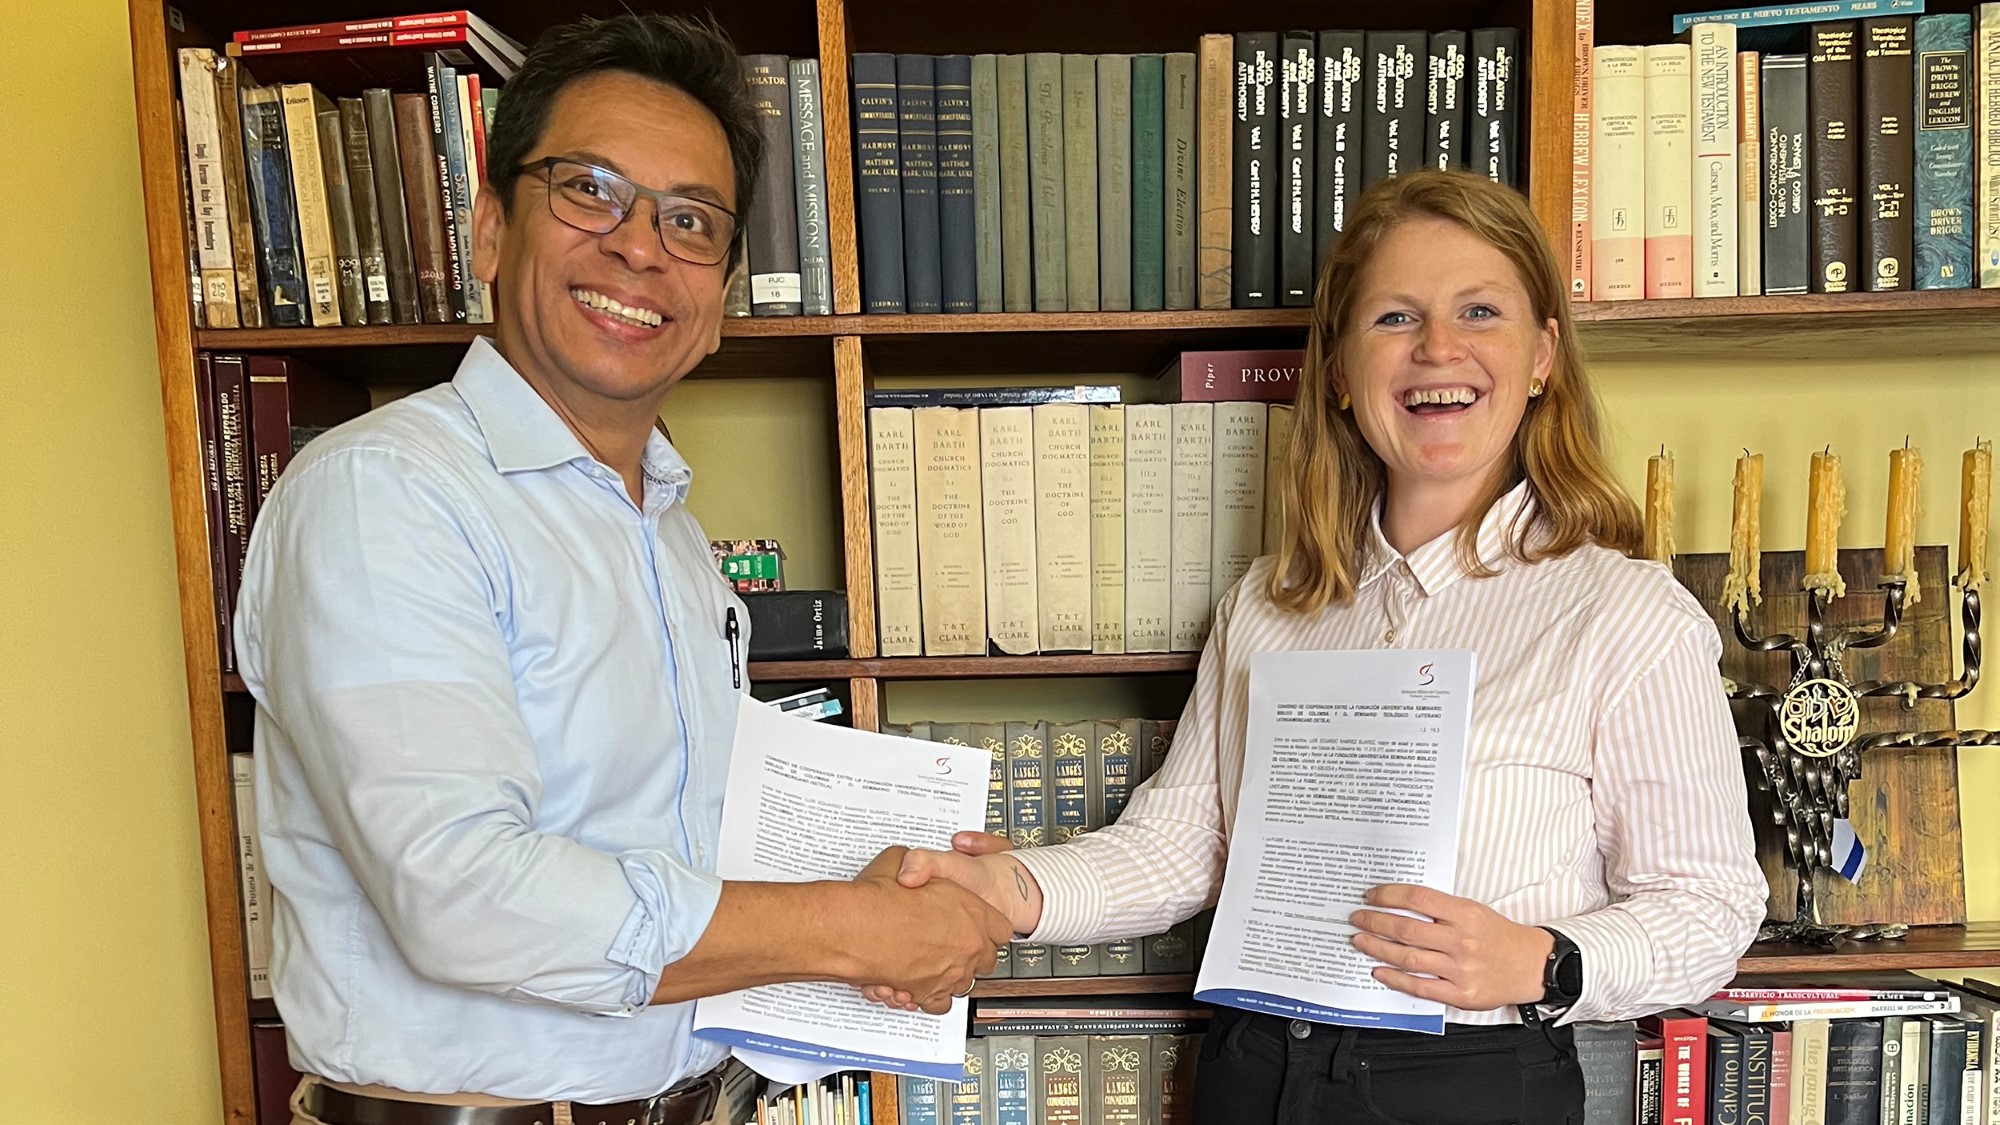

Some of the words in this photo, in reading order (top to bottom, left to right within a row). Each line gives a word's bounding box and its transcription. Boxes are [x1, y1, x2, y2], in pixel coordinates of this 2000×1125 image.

[1741, 11, 1752, 19] EL
[1753, 9, 1783, 18] NUEVO
[1784, 4, 1840, 16] TESTAMENTO
[1579, 32, 1586, 41] to
[1701, 32, 1714, 45] TO
[1872, 27, 1907, 35] Theological
[1581, 43, 1589, 76] BROWN
[1701, 47, 1714, 66] THE
[1716, 45, 1728, 59] AN
[1866, 49, 1880, 57] Old
[427, 66, 437, 94] WAYNE
[1256, 50, 1265, 115] REVELATION
[1341, 47, 1353, 112] REVELATION
[1377, 52, 1387, 113] AUTHORITY
[1394, 44, 1405, 109] REVELATION
[1496, 46, 1506, 111] REVELATION
[1701, 69, 1715, 89] NEW
[1930, 82, 1959, 90] BRIGGS
[1988, 73, 2000, 86] DE
[1238, 61, 1247, 121] AUTHORITY
[1323, 56, 1334, 118] AUTHORITY
[1477, 56, 1488, 117] AUTHORITY
[1580, 76, 1589, 109] DRIVER
[1716, 62, 1729, 130] INTRODUCTION
[1929, 91, 1961, 99] HEBREW
[861, 97, 894, 106] CALVIN'S
[939, 98, 970, 107] CALVIN'S
[1928, 107, 1961, 115] ENGLISH
[1939, 99, 1952, 107] and
[1988, 88, 2000, 126] HEBREO
[431, 95, 441, 134] CORDEIRO
[798, 79, 816, 151] MESSAGE
[1701, 92, 1716, 143] TESTAMENT
[1928, 115, 1961, 124] LEXICON
[861, 142, 897, 150] HARMONY
[1388, 138, 1398, 150] IV
[1573, 113, 1589, 166] HEBREW
[1176, 138, 1188, 182] Divine
[1778, 134, 1788, 184] TESTAMENTO
[1792, 133, 1803, 169] ESPAÑOL
[802, 154, 816, 179] and
[864, 158, 895, 167] MATTHEW
[883, 168, 899, 177] LUKE
[1709, 161, 1722, 195] Carson,
[442, 189, 452, 209] CON
[1572, 170, 1589, 221] LEXICON
[1778, 187, 1787, 217] NUEVO
[1792, 180, 1802, 214] GRIEGO
[804, 182, 820, 249] MISSION
[1176, 187, 1188, 238] Election
[1930, 208, 1962, 218] BROWN
[1930, 216, 1963, 227] DRIVER
[1711, 220, 1723, 237] and
[1930, 225, 1963, 236] BRIGGS
[1711, 237, 1723, 266] Morris
[1205, 362, 1215, 390] Piper
[1230, 416, 1256, 424] KARL
[936, 429, 962, 437] KARL
[1131, 433, 1166, 441] BARTH
[1225, 428, 1259, 436] BARTH
[933, 441, 965, 449] BARTH
[813, 599, 823, 621] Ortiz
[813, 623, 824, 650] Jaime
[939, 633, 970, 642] CLARK
[1052, 624, 1084, 632] CLARK
[1133, 629, 1166, 637] CLARK
[1785, 717, 1854, 743] Shalom
[1741, 991, 1775, 999] SERVICIO
[1777, 991, 1840, 999] TRANSCULTURAL
[1905, 1003, 1935, 1011] JOHNSON
[1677, 1045, 1690, 1060] THE
[1720, 1043, 1739, 1054] II
[1677, 1062, 1690, 1094] WORKS
[1718, 1059, 1740, 1125] Calvino
[1677, 1097, 1690, 1108] OF
